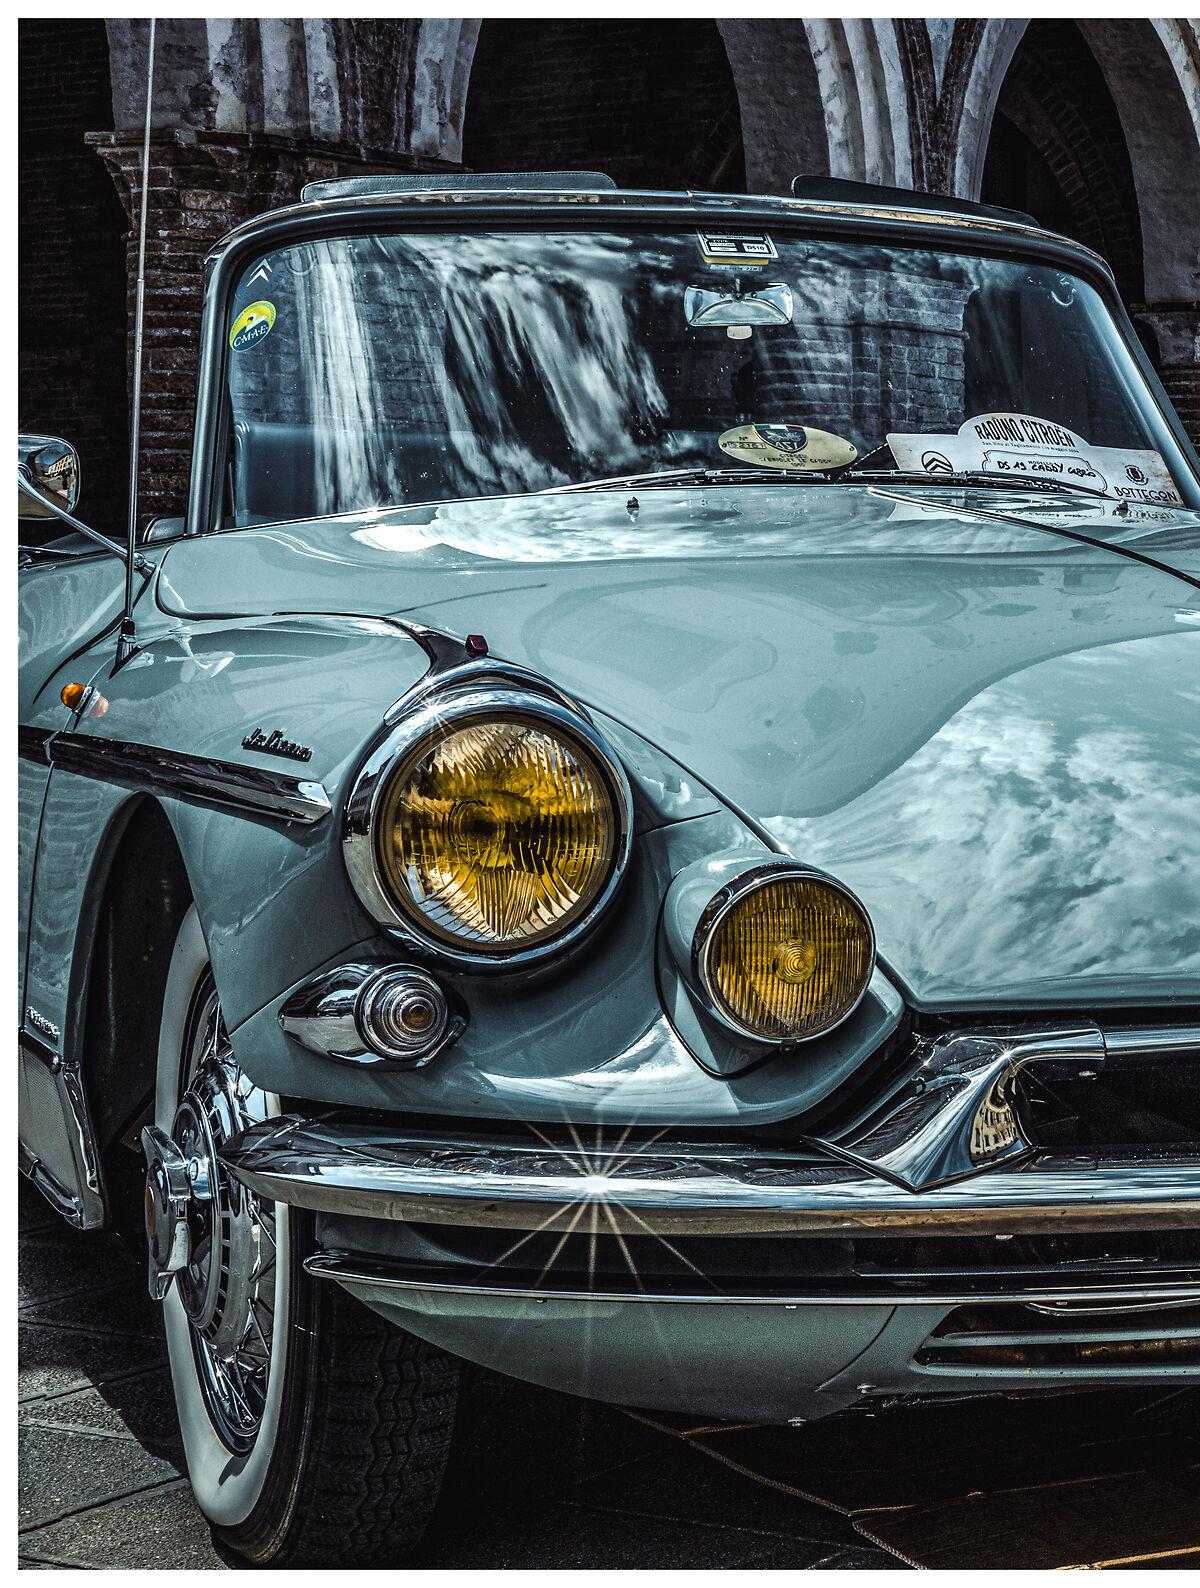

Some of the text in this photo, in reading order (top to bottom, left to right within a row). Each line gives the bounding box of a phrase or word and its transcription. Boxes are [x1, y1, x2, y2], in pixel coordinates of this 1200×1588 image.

[974, 418, 1076, 448] RADUNO CITROËN
[997, 460, 1011, 471] DS
[1013, 460, 1027, 471] 19
[1031, 462, 1064, 473] CADDY
[1113, 485, 1179, 502] BOTTEGON
